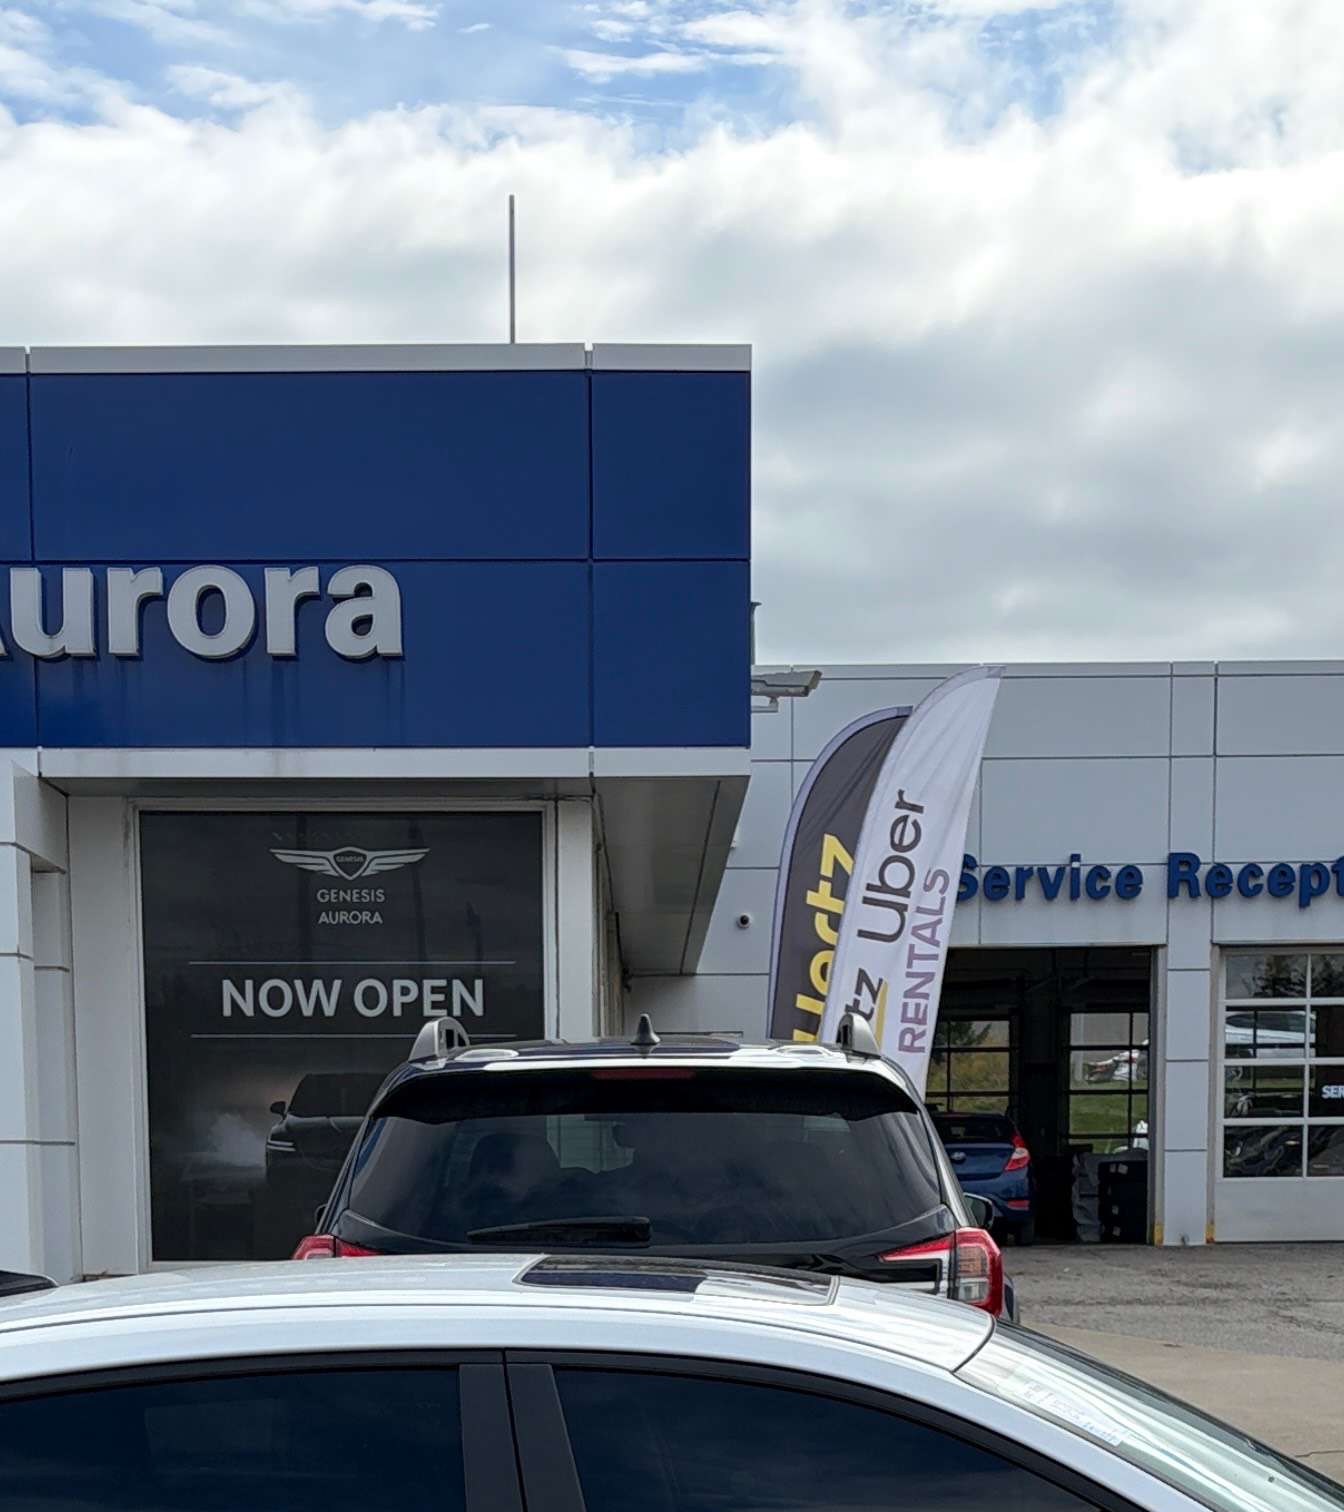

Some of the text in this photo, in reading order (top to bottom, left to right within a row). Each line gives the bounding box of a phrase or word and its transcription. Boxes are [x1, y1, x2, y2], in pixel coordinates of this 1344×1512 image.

[857, 789, 925, 943] Uber
[956, 853, 1143, 901] Service
[317, 888, 385, 903] GENESIS
[318, 910, 384, 925] AURORA
[898, 867, 951, 1054] RENTALS
[221, 978, 485, 1018] NOW OPEN
